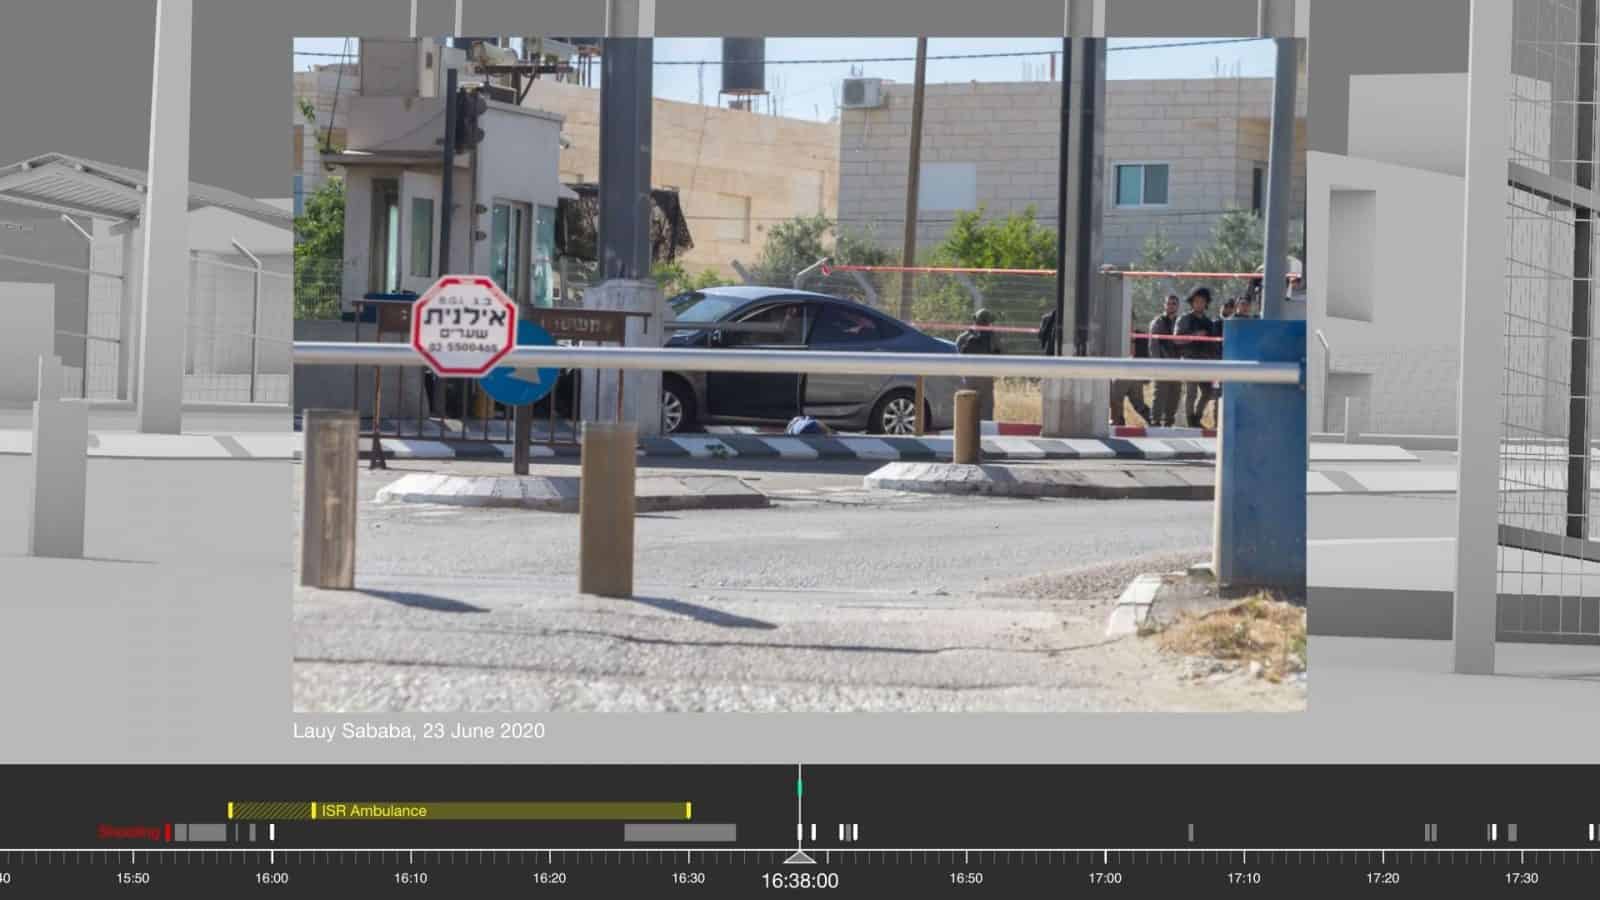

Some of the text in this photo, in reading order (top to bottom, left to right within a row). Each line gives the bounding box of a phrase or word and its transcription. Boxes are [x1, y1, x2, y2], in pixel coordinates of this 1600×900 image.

[424, 307, 506, 326] אילנית
[439, 328, 489, 339] שערים
[429, 342, 442, 352] 02
